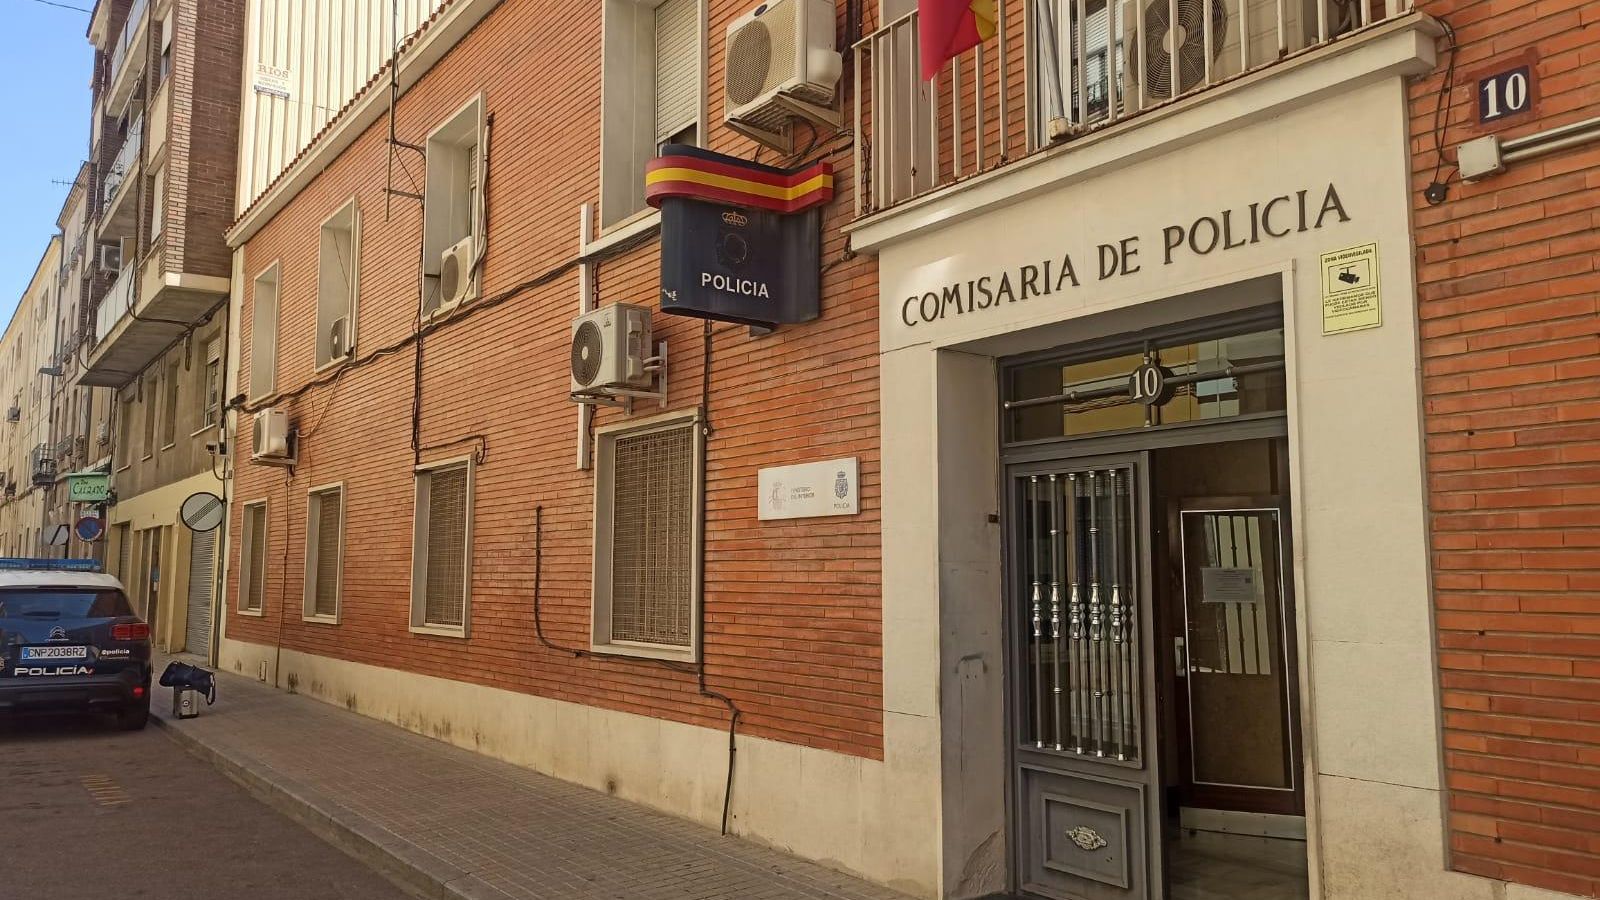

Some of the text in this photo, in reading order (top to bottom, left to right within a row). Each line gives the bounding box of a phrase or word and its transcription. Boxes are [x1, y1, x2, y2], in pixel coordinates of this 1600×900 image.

[258, 64, 289, 79] RIOS
[1483, 73, 1527, 119] 10
[901, 182, 1352, 327] COMISARIA DE POLICIA
[701, 272, 770, 299] POLICIA
[1132, 367, 1158, 400] 10
